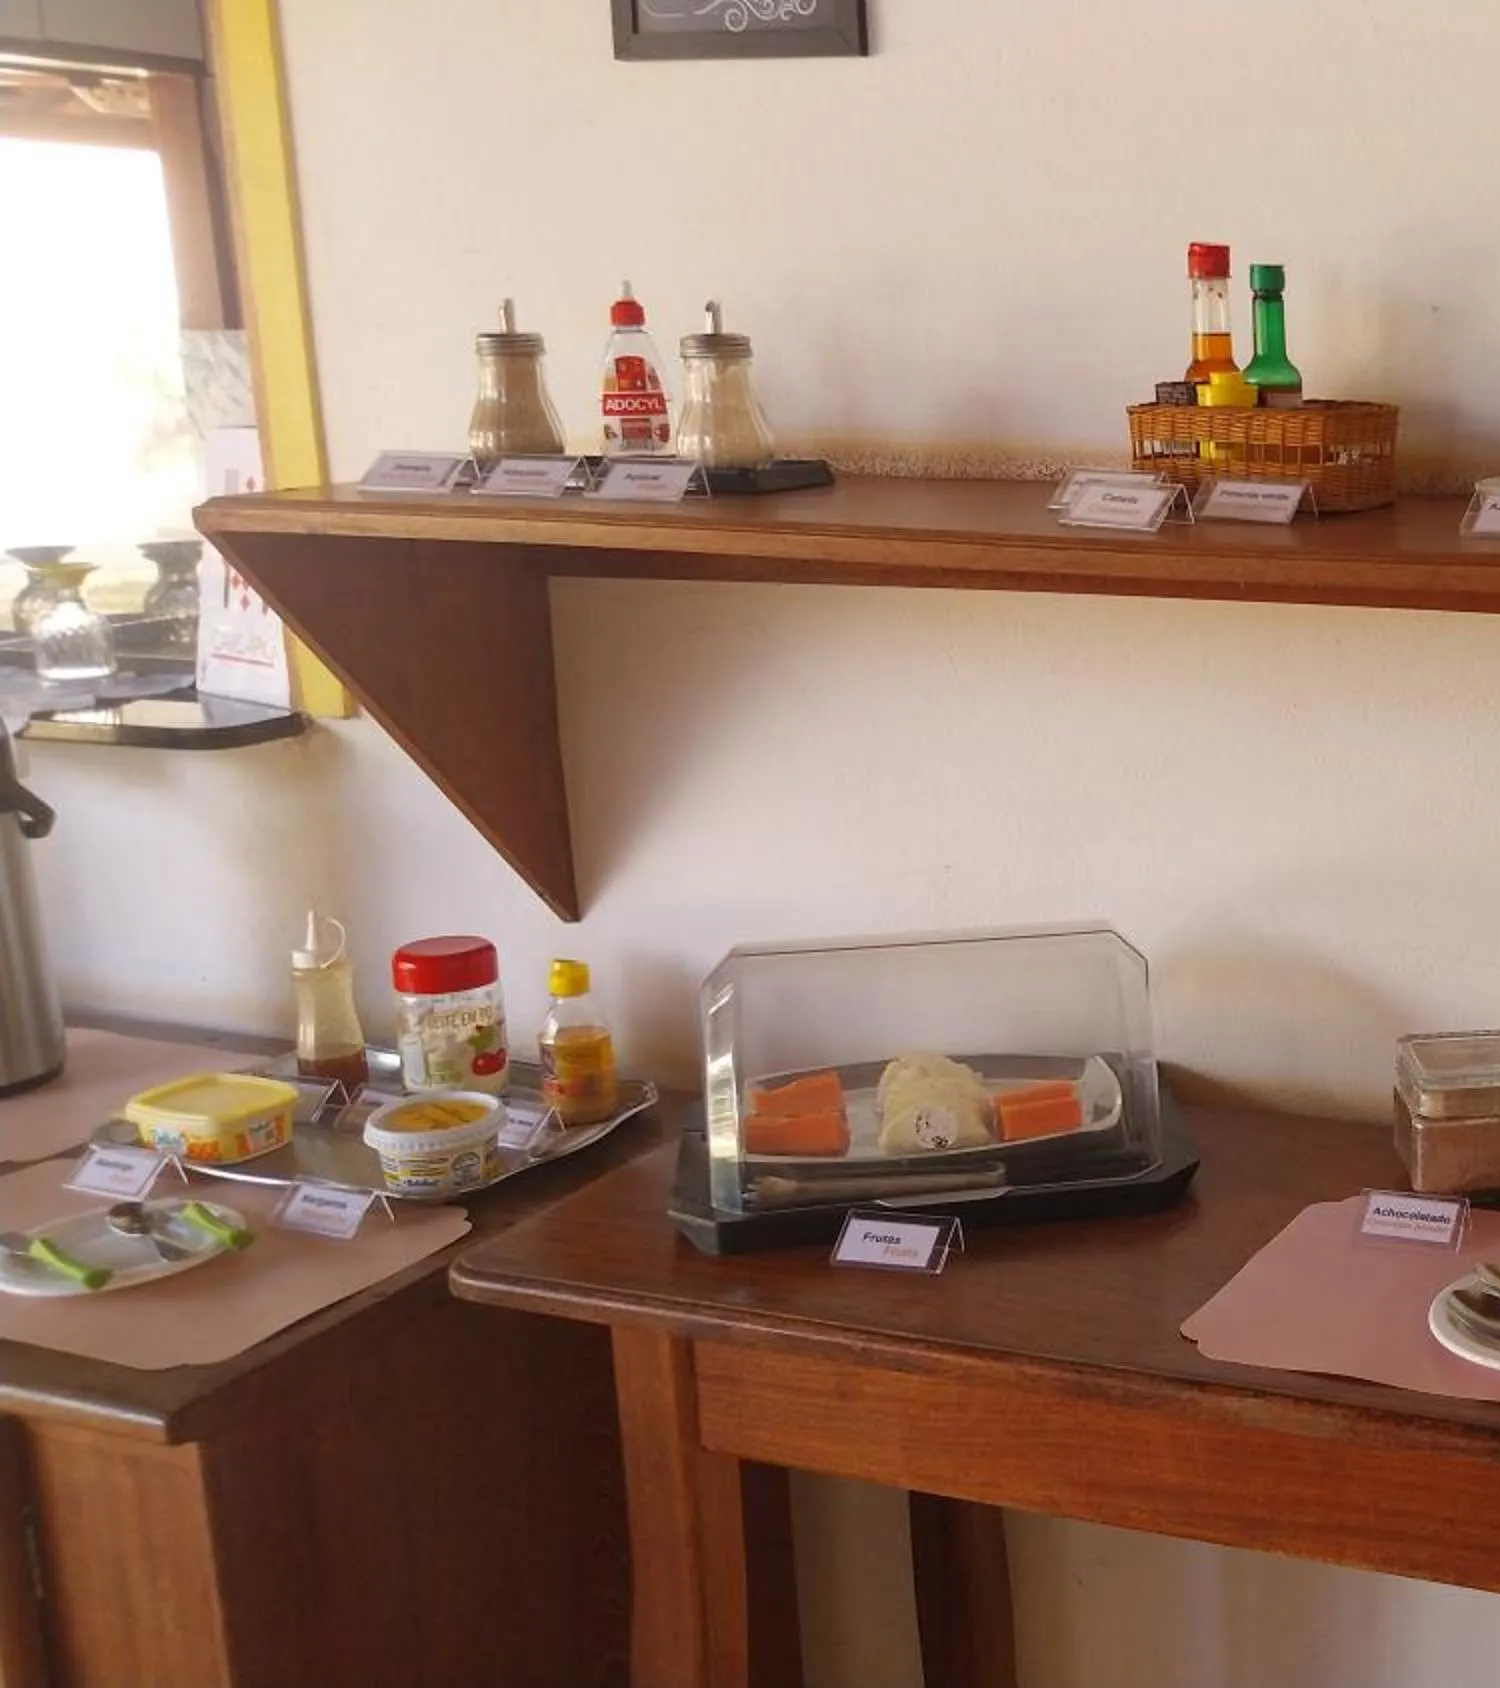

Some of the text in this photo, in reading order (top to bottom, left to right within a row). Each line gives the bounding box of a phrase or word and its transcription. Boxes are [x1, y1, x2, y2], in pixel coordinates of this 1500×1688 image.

[605, 396, 662, 412] ADOCYL
[1373, 1206, 1450, 1225] Achocolatado
[863, 1231, 901, 1245] Frutas
